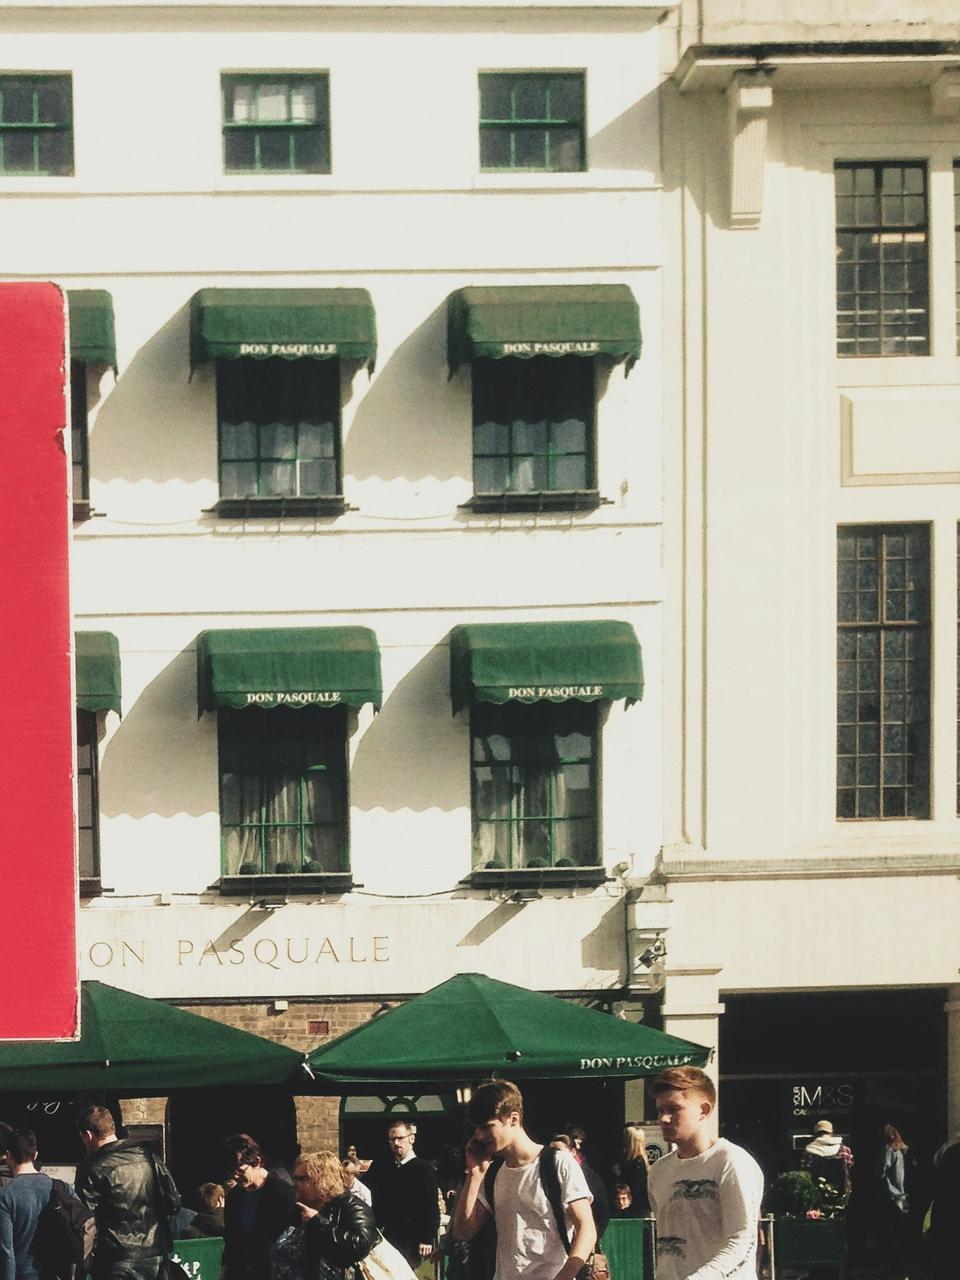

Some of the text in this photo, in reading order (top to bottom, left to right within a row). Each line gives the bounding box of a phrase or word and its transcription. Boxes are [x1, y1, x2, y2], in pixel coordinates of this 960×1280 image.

[241, 343, 337, 356] DON PASQUALE
[504, 342, 599, 353] DON PASQUALE
[247, 692, 341, 704] DON PASQUALE
[509, 686, 603, 698] DON PASQUALE
[80, 936, 390, 969] ON PASQUALE
[581, 1058, 612, 1070] DON
